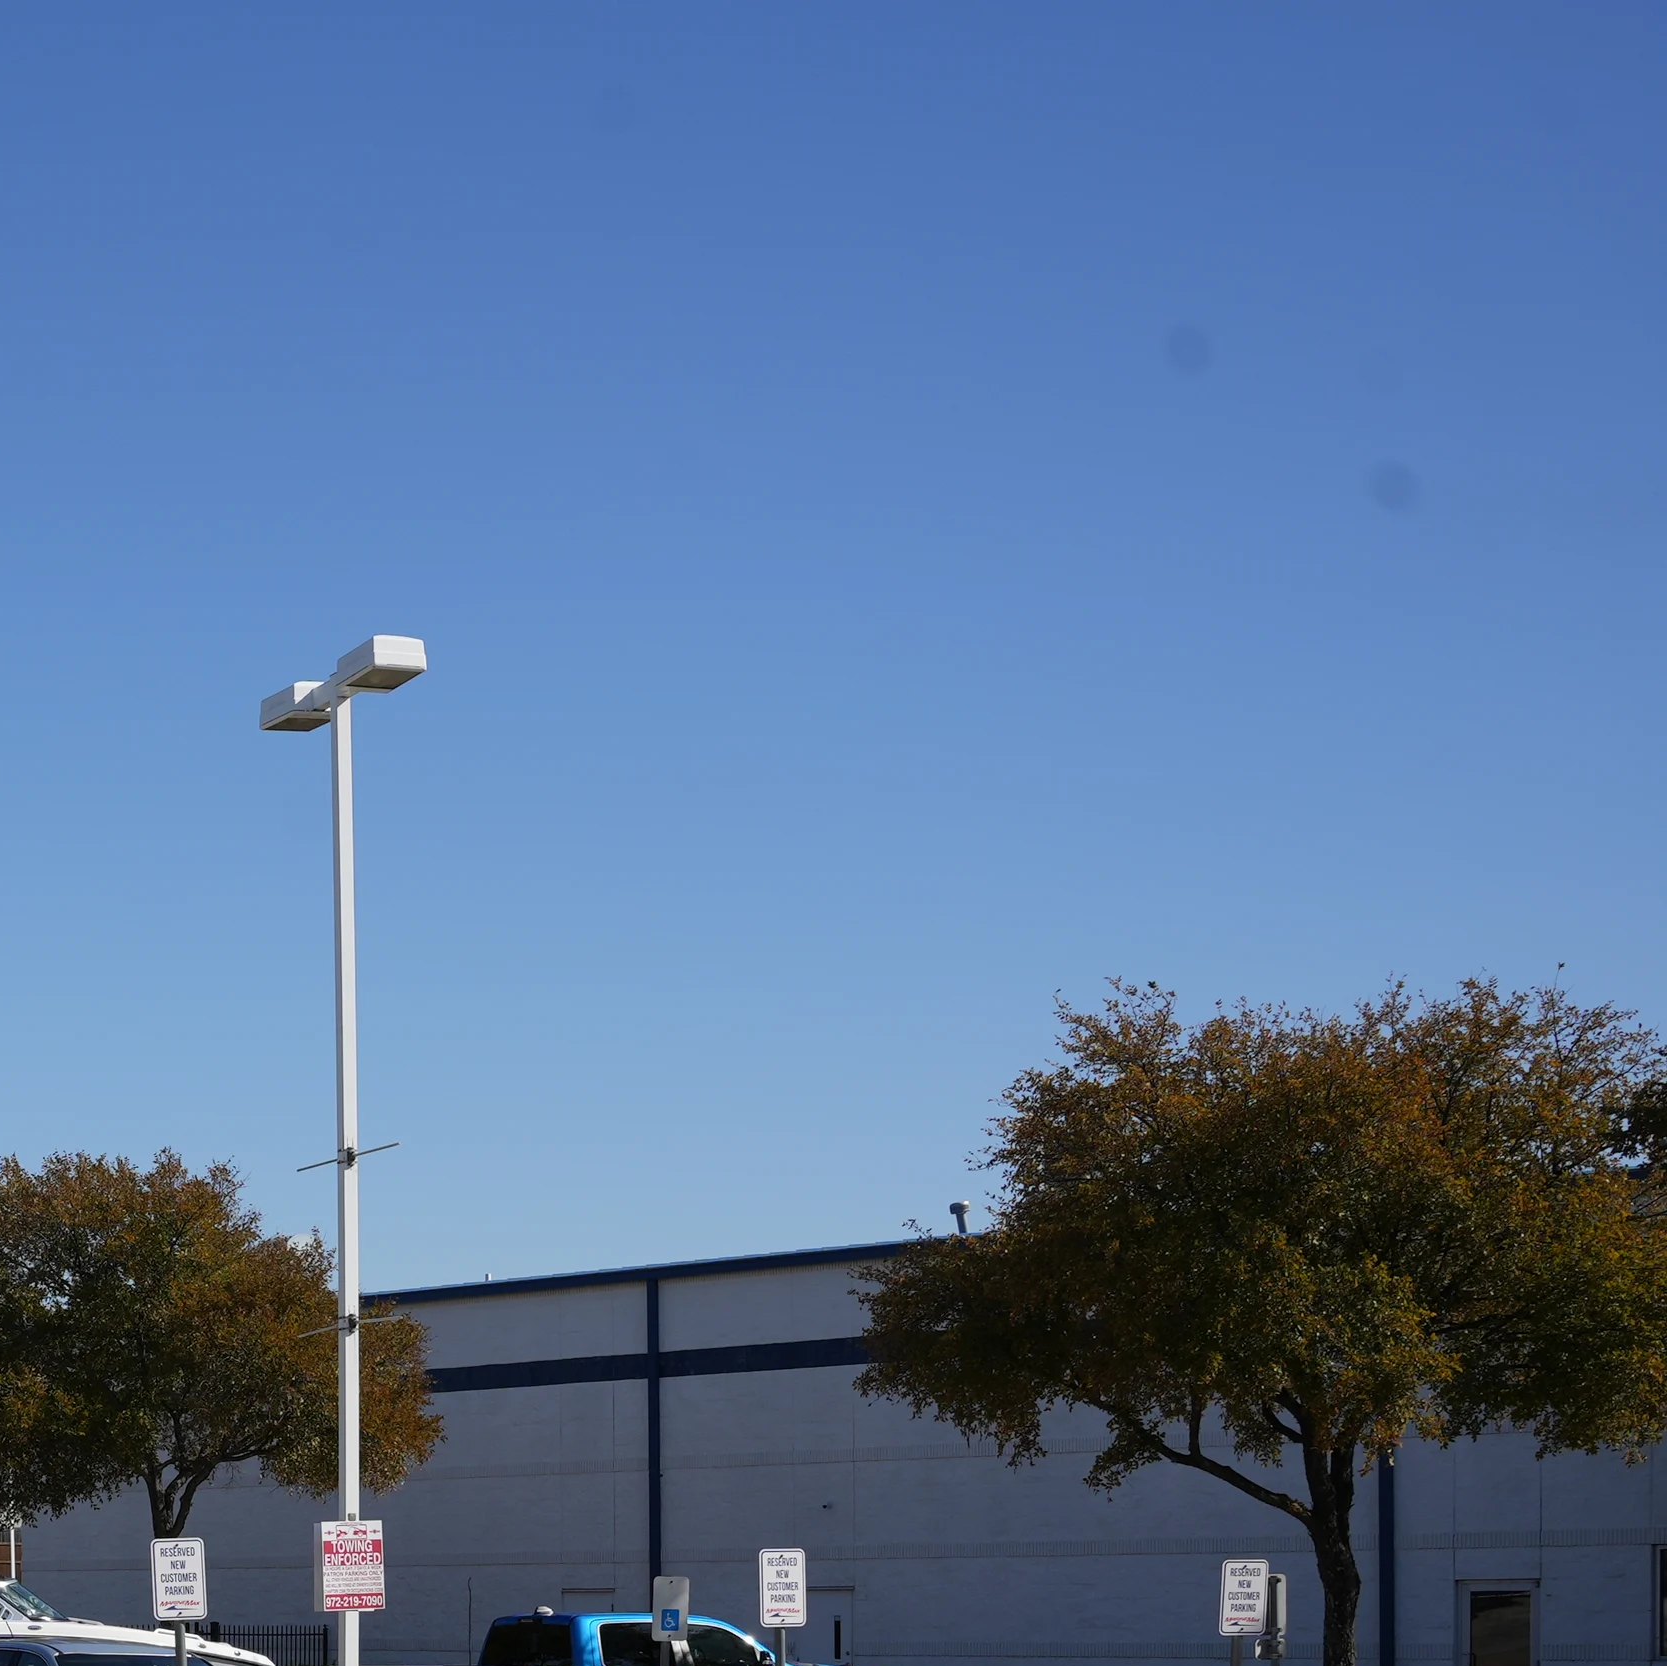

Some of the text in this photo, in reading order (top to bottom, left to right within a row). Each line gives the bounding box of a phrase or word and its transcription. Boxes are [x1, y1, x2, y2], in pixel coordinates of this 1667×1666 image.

[331, 1540, 372, 1553] TOWING
[160, 1547, 195, 1557] RESERVED
[325, 1553, 381, 1566] ENFORCED
[767, 1558, 797, 1566] RESERVED
[171, 1560, 186, 1569] NEW
[776, 1570, 789, 1578] NEW
[1230, 1568, 1261, 1577] RESERVED
[161, 1573, 197, 1583] CUSTOMER
[767, 1582, 798, 1591] CUSTOMER
[1238, 1580, 1251, 1588] NEW
[165, 1586, 194, 1595] PARKING
[771, 1594, 795, 1603] PARKING
[1228, 1592, 1260, 1600] CUSTOMER
[326, 1595, 383, 1607] 972-219-7090
[1230, 1604, 1256, 1612] PARKING
